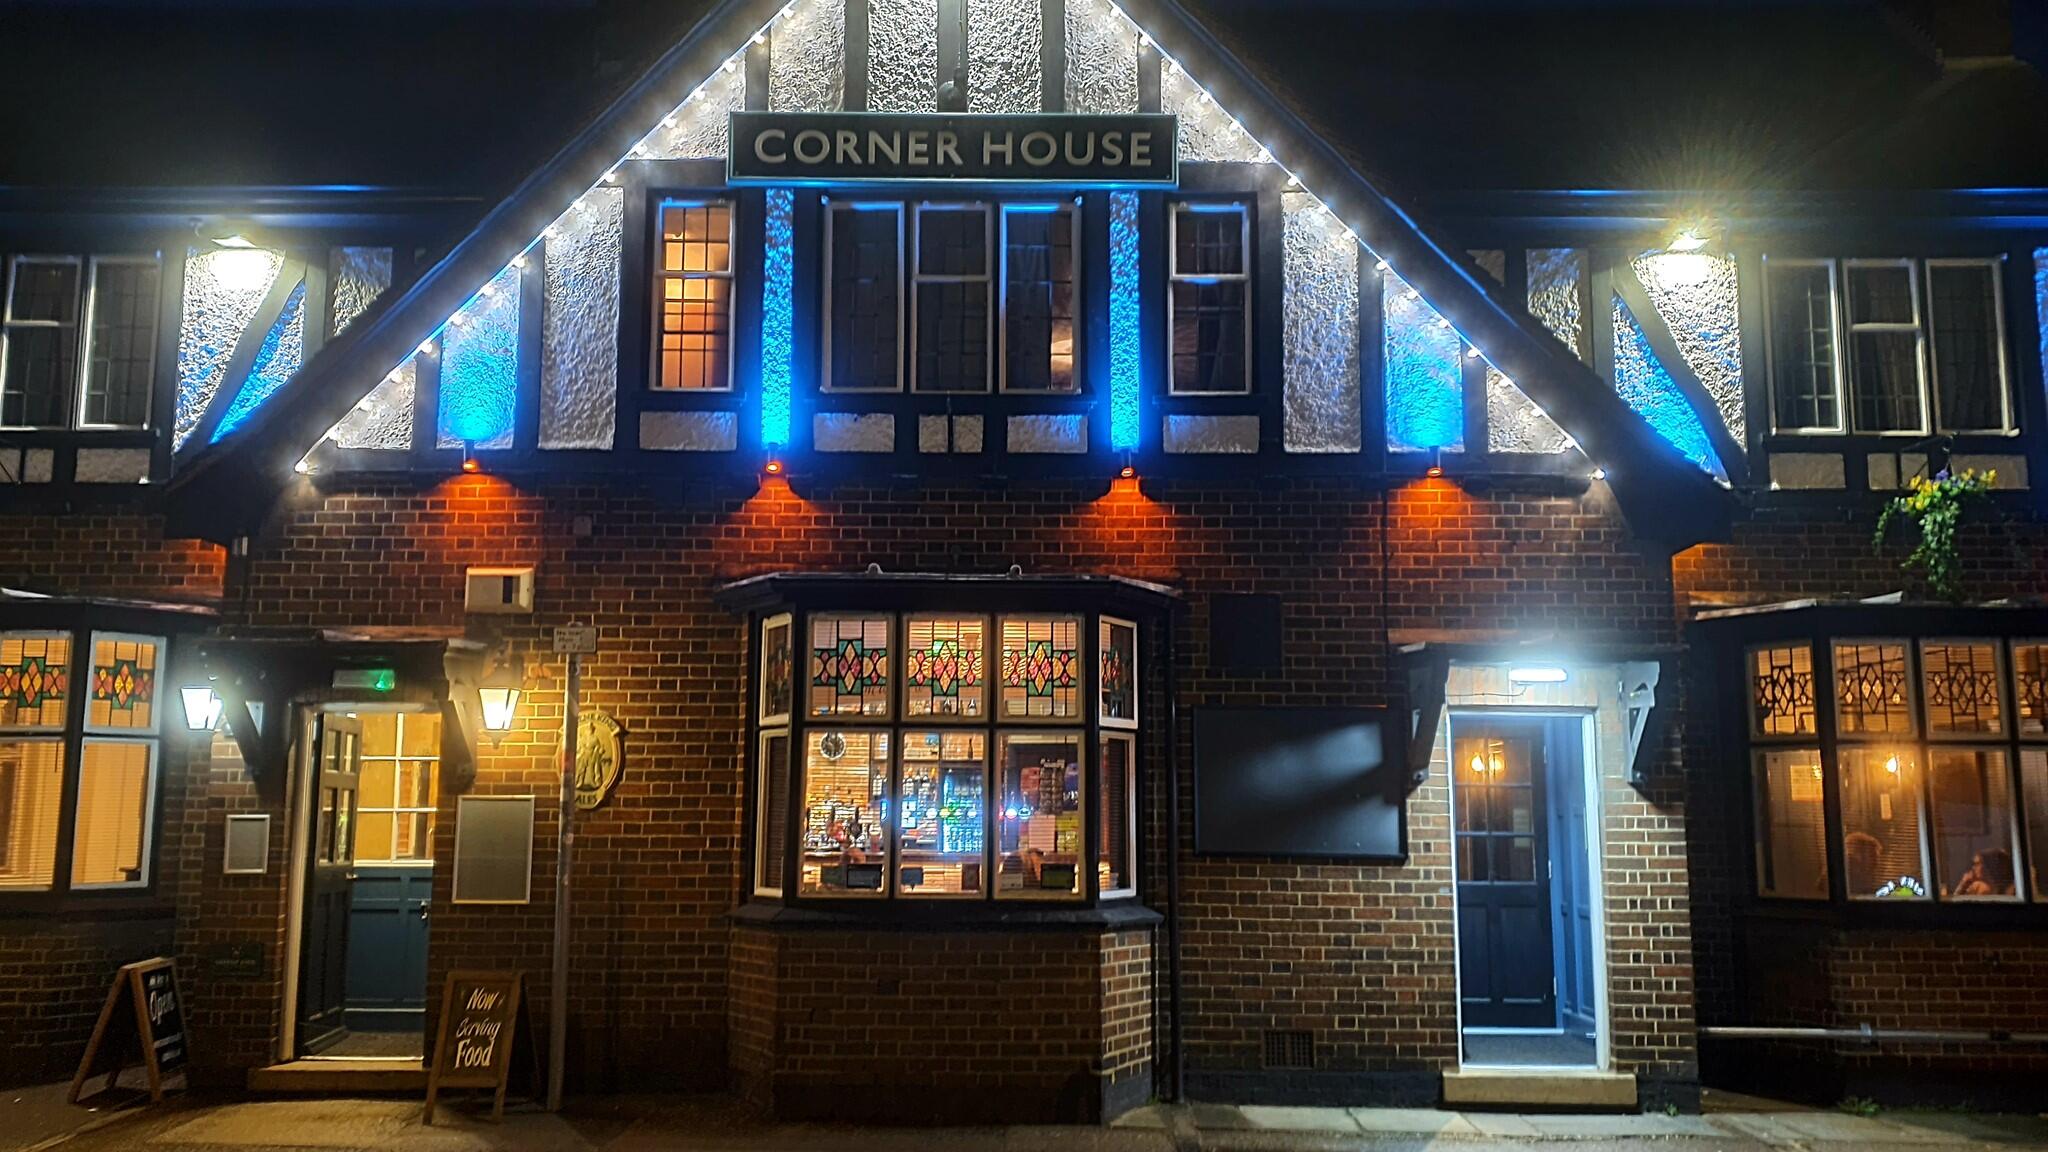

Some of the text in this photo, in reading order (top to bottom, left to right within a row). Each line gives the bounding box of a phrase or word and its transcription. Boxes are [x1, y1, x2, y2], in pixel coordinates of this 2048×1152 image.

[754, 128, 1152, 166] CORNER HOUSE
[465, 986, 499, 1011] Now
[456, 1017, 501, 1041] Serving
[455, 1039, 494, 1069] Food
